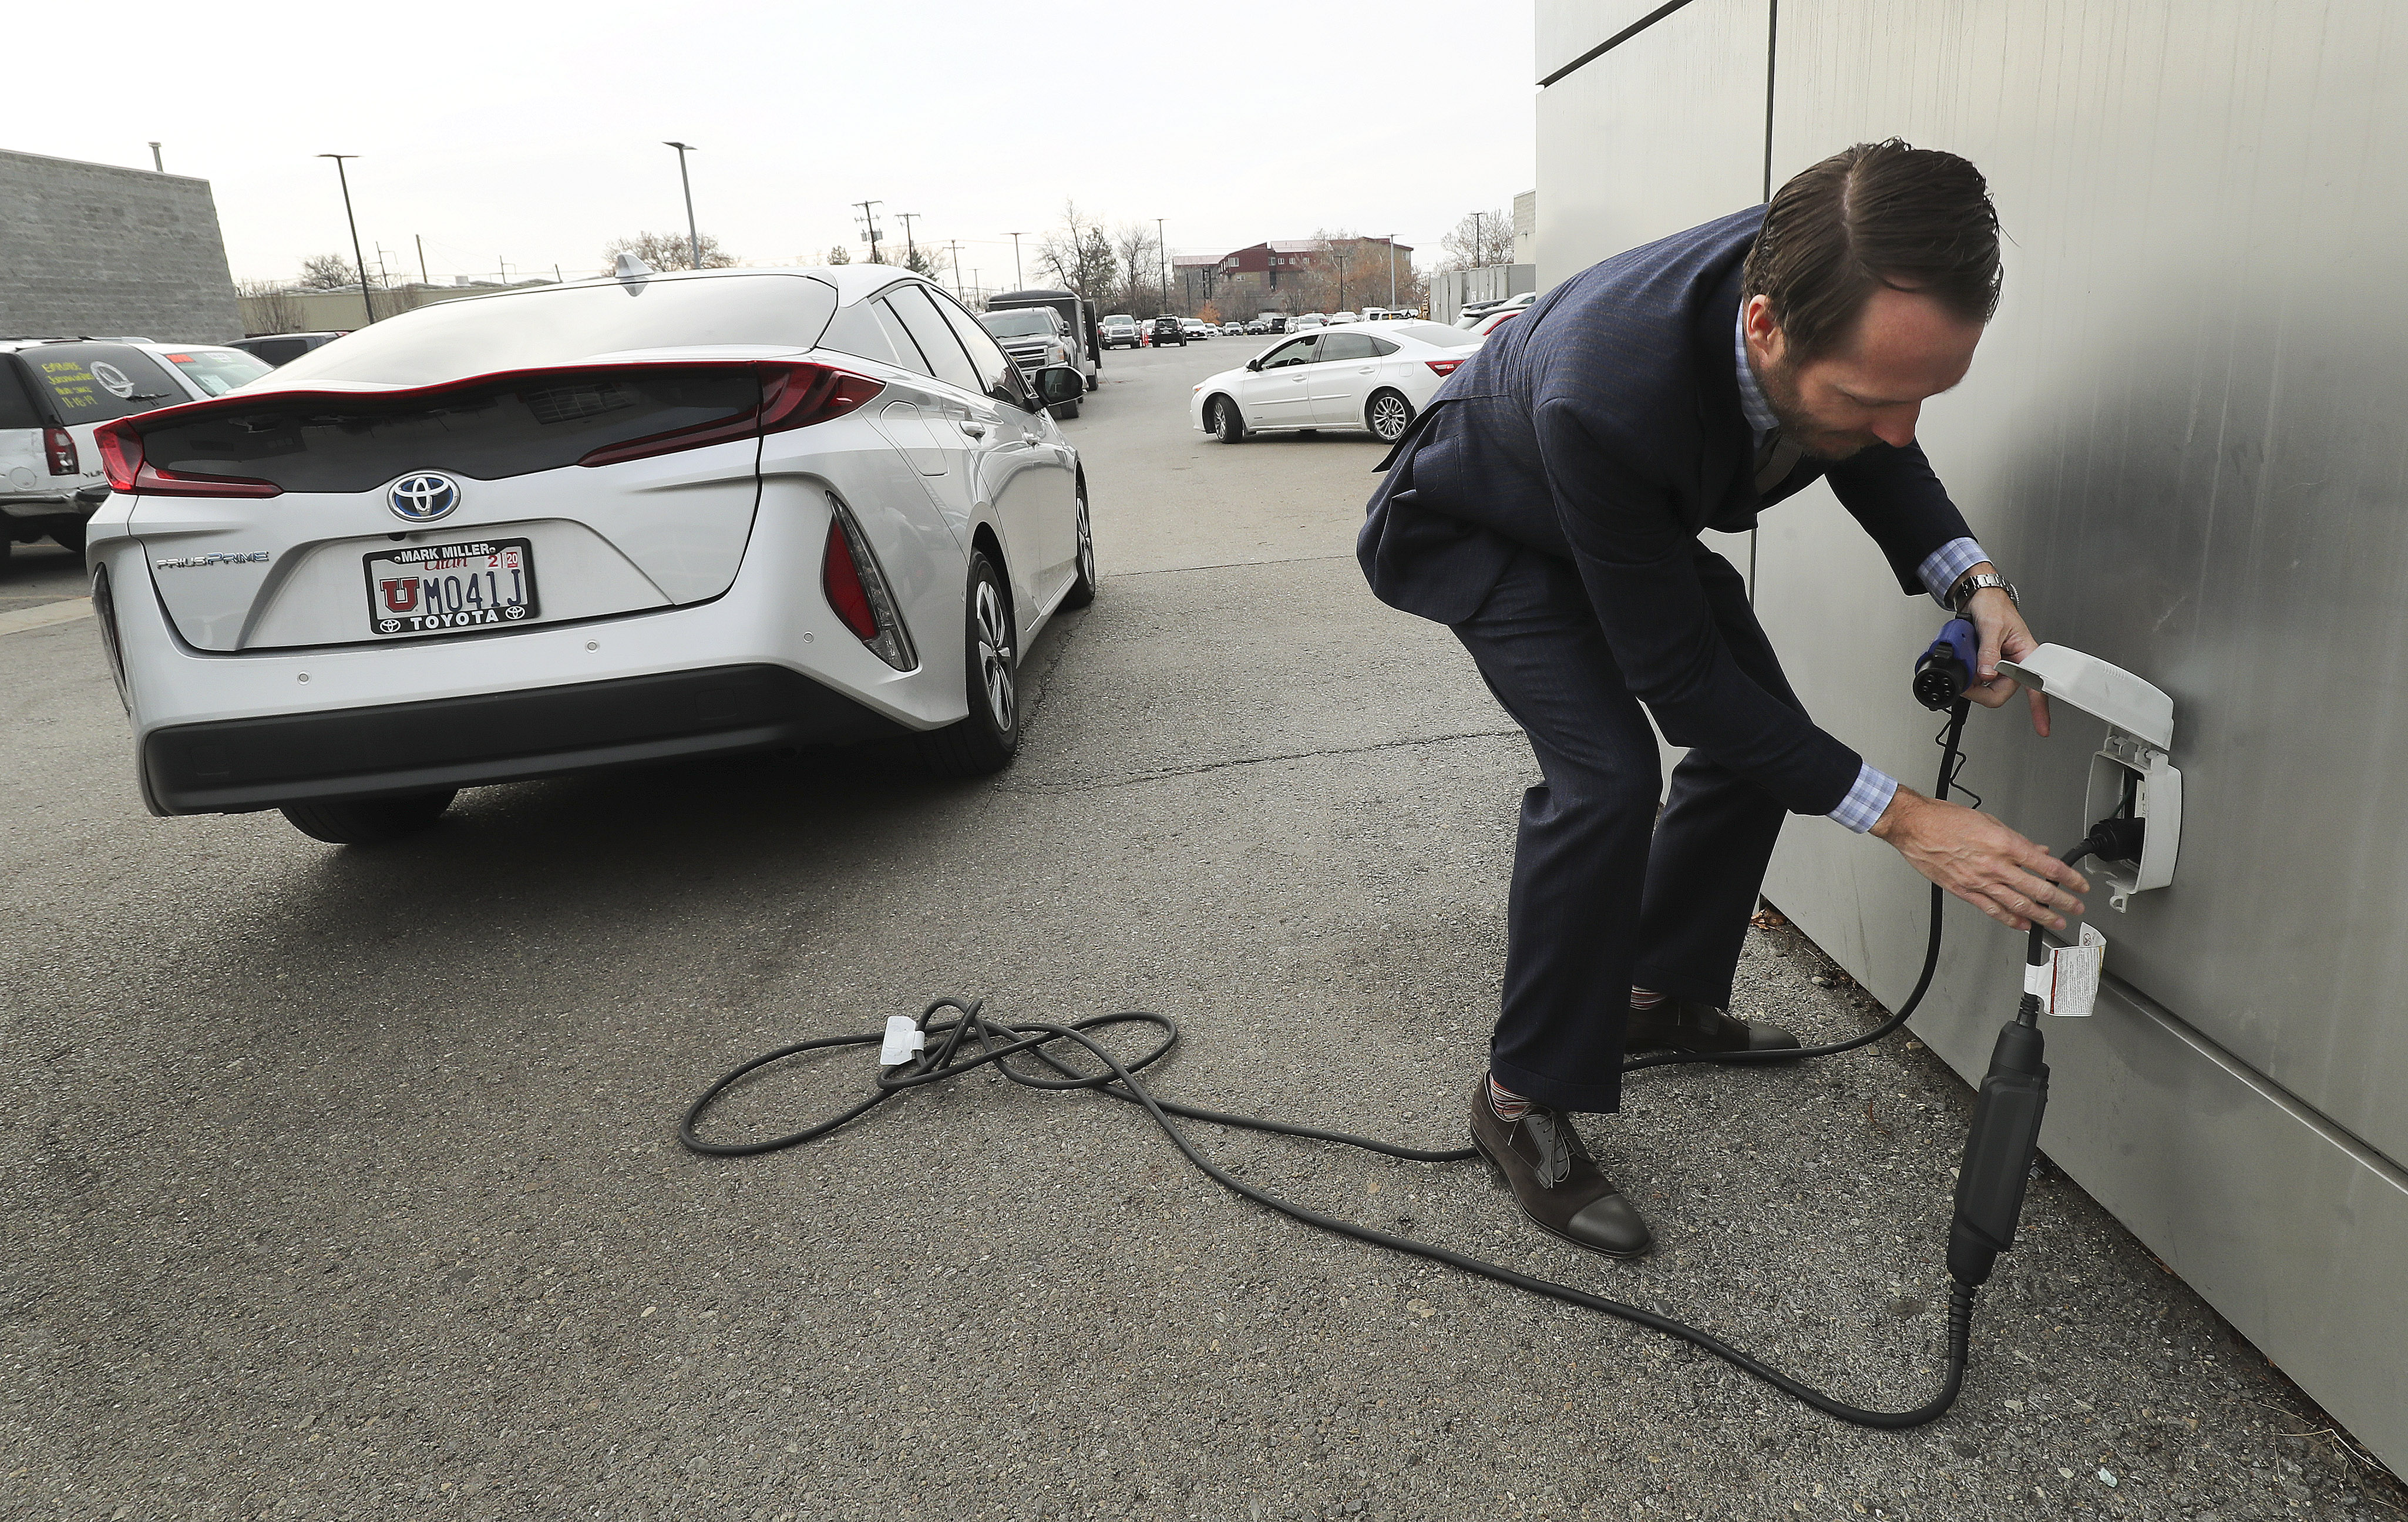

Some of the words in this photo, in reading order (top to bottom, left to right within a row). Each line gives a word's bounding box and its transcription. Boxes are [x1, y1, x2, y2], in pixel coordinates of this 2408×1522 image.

[401, 548, 439, 562] MARK
[442, 543, 490, 558] MILLER
[507, 553, 517, 564] 20
[488, 555, 498, 567] 2
[411, 609, 499, 630] TOYOTA
